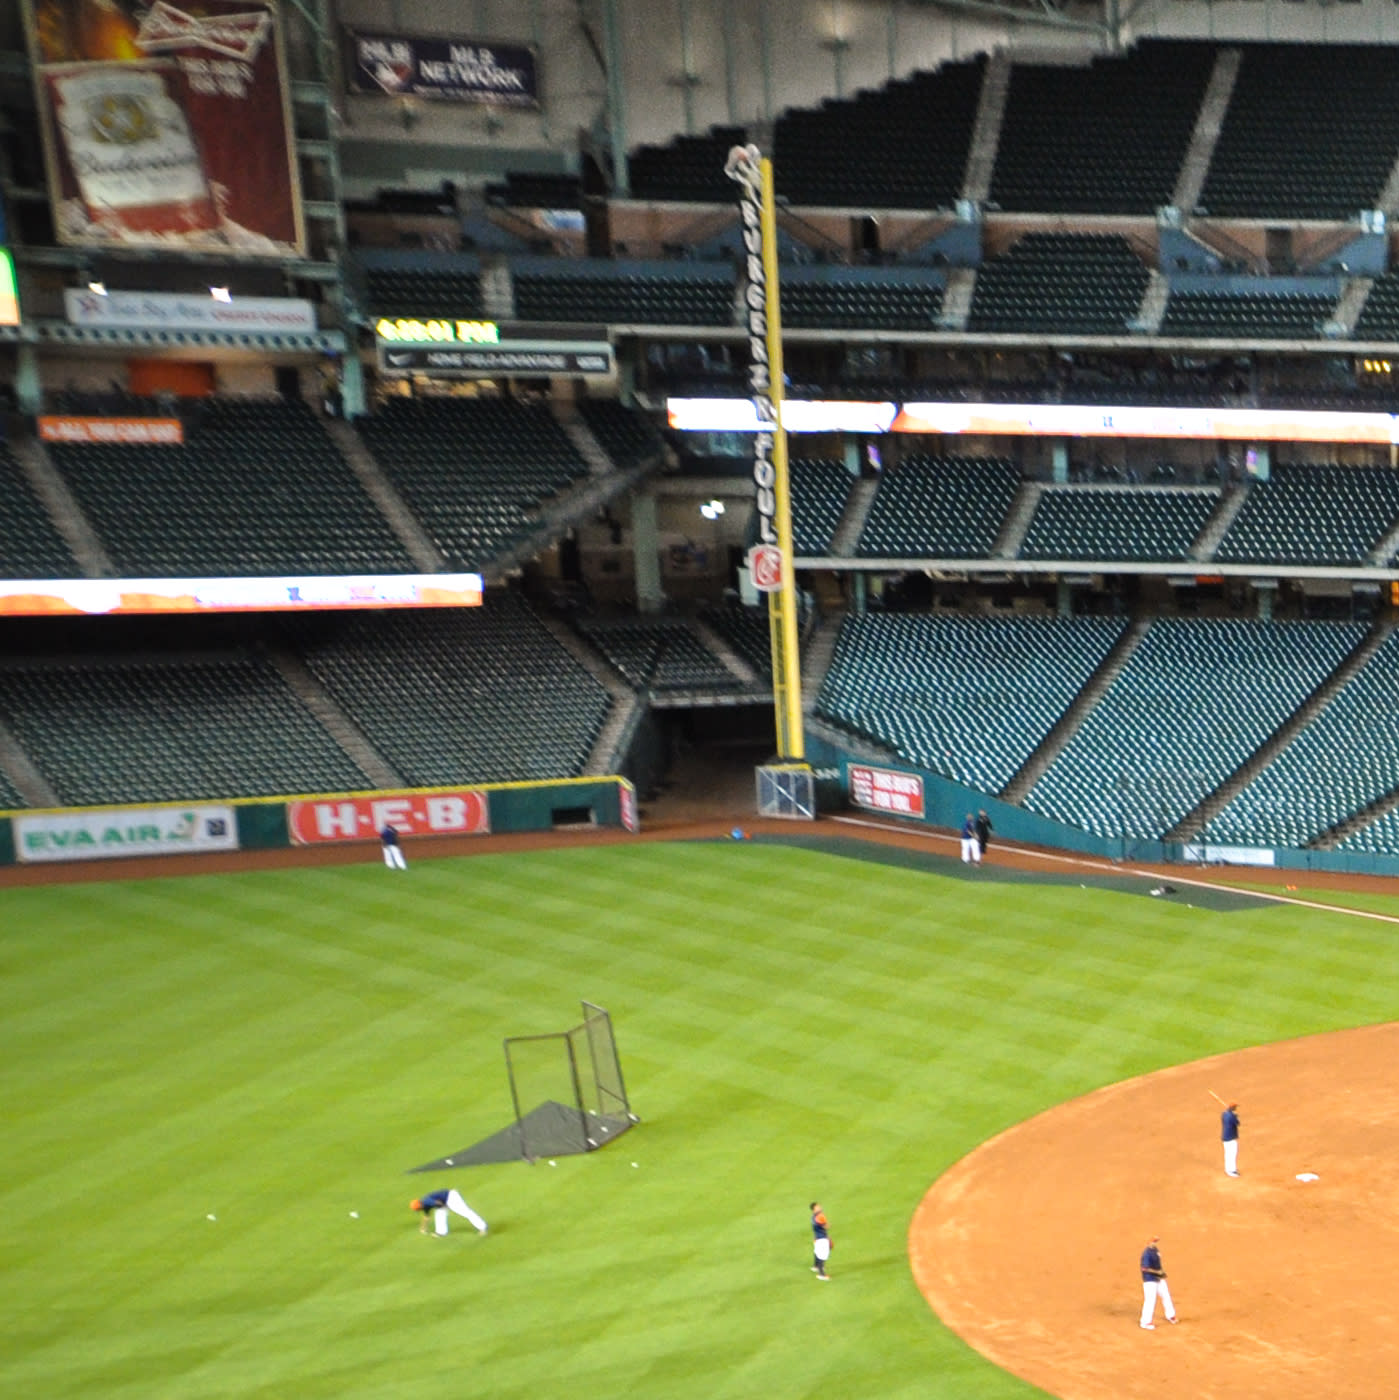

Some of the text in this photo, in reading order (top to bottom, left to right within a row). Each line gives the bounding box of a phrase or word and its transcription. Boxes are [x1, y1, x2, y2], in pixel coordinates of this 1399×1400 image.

[419, 60, 525, 91] NETWORK
[754, 431, 779, 544] FOUL
[24, 825, 161, 849] EVA AIR
